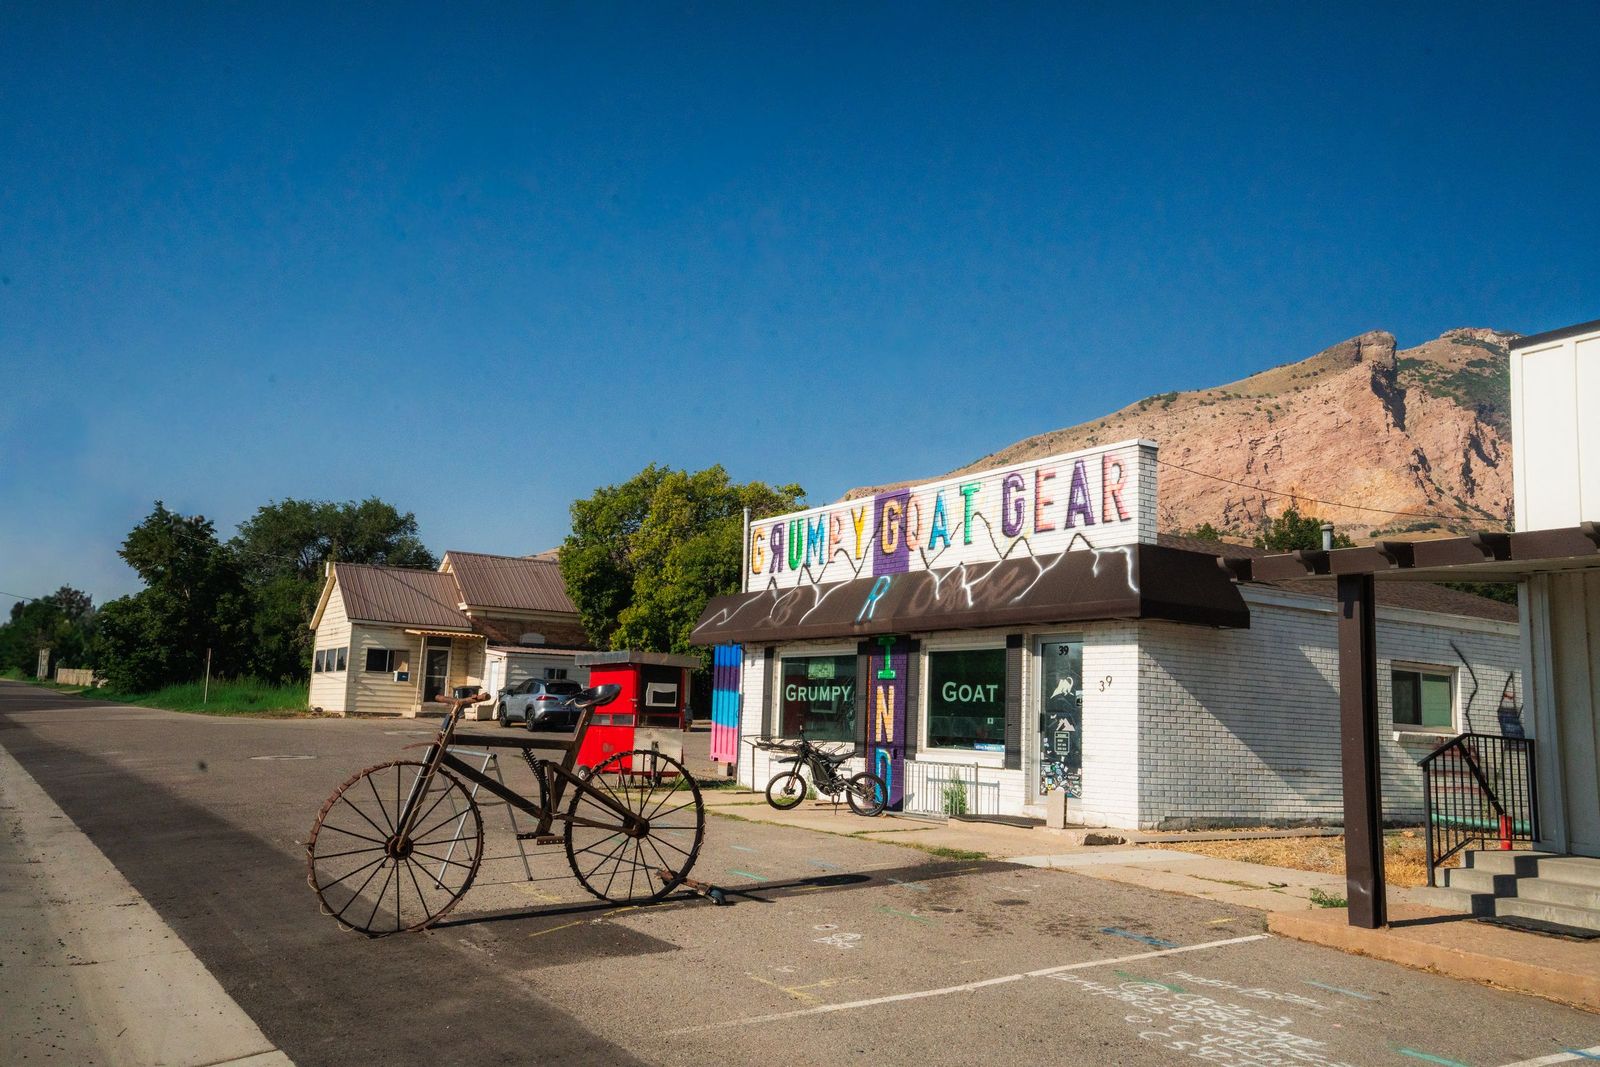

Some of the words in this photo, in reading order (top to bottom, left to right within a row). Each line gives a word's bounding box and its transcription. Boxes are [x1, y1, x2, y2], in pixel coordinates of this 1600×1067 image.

[752, 506, 868, 574] GRUMPY
[881, 482, 982, 554] GOAT
[1002, 453, 1132, 538] GEAR
[1058, 645, 1069, 656] 39
[1099, 675, 1113, 693] 39
